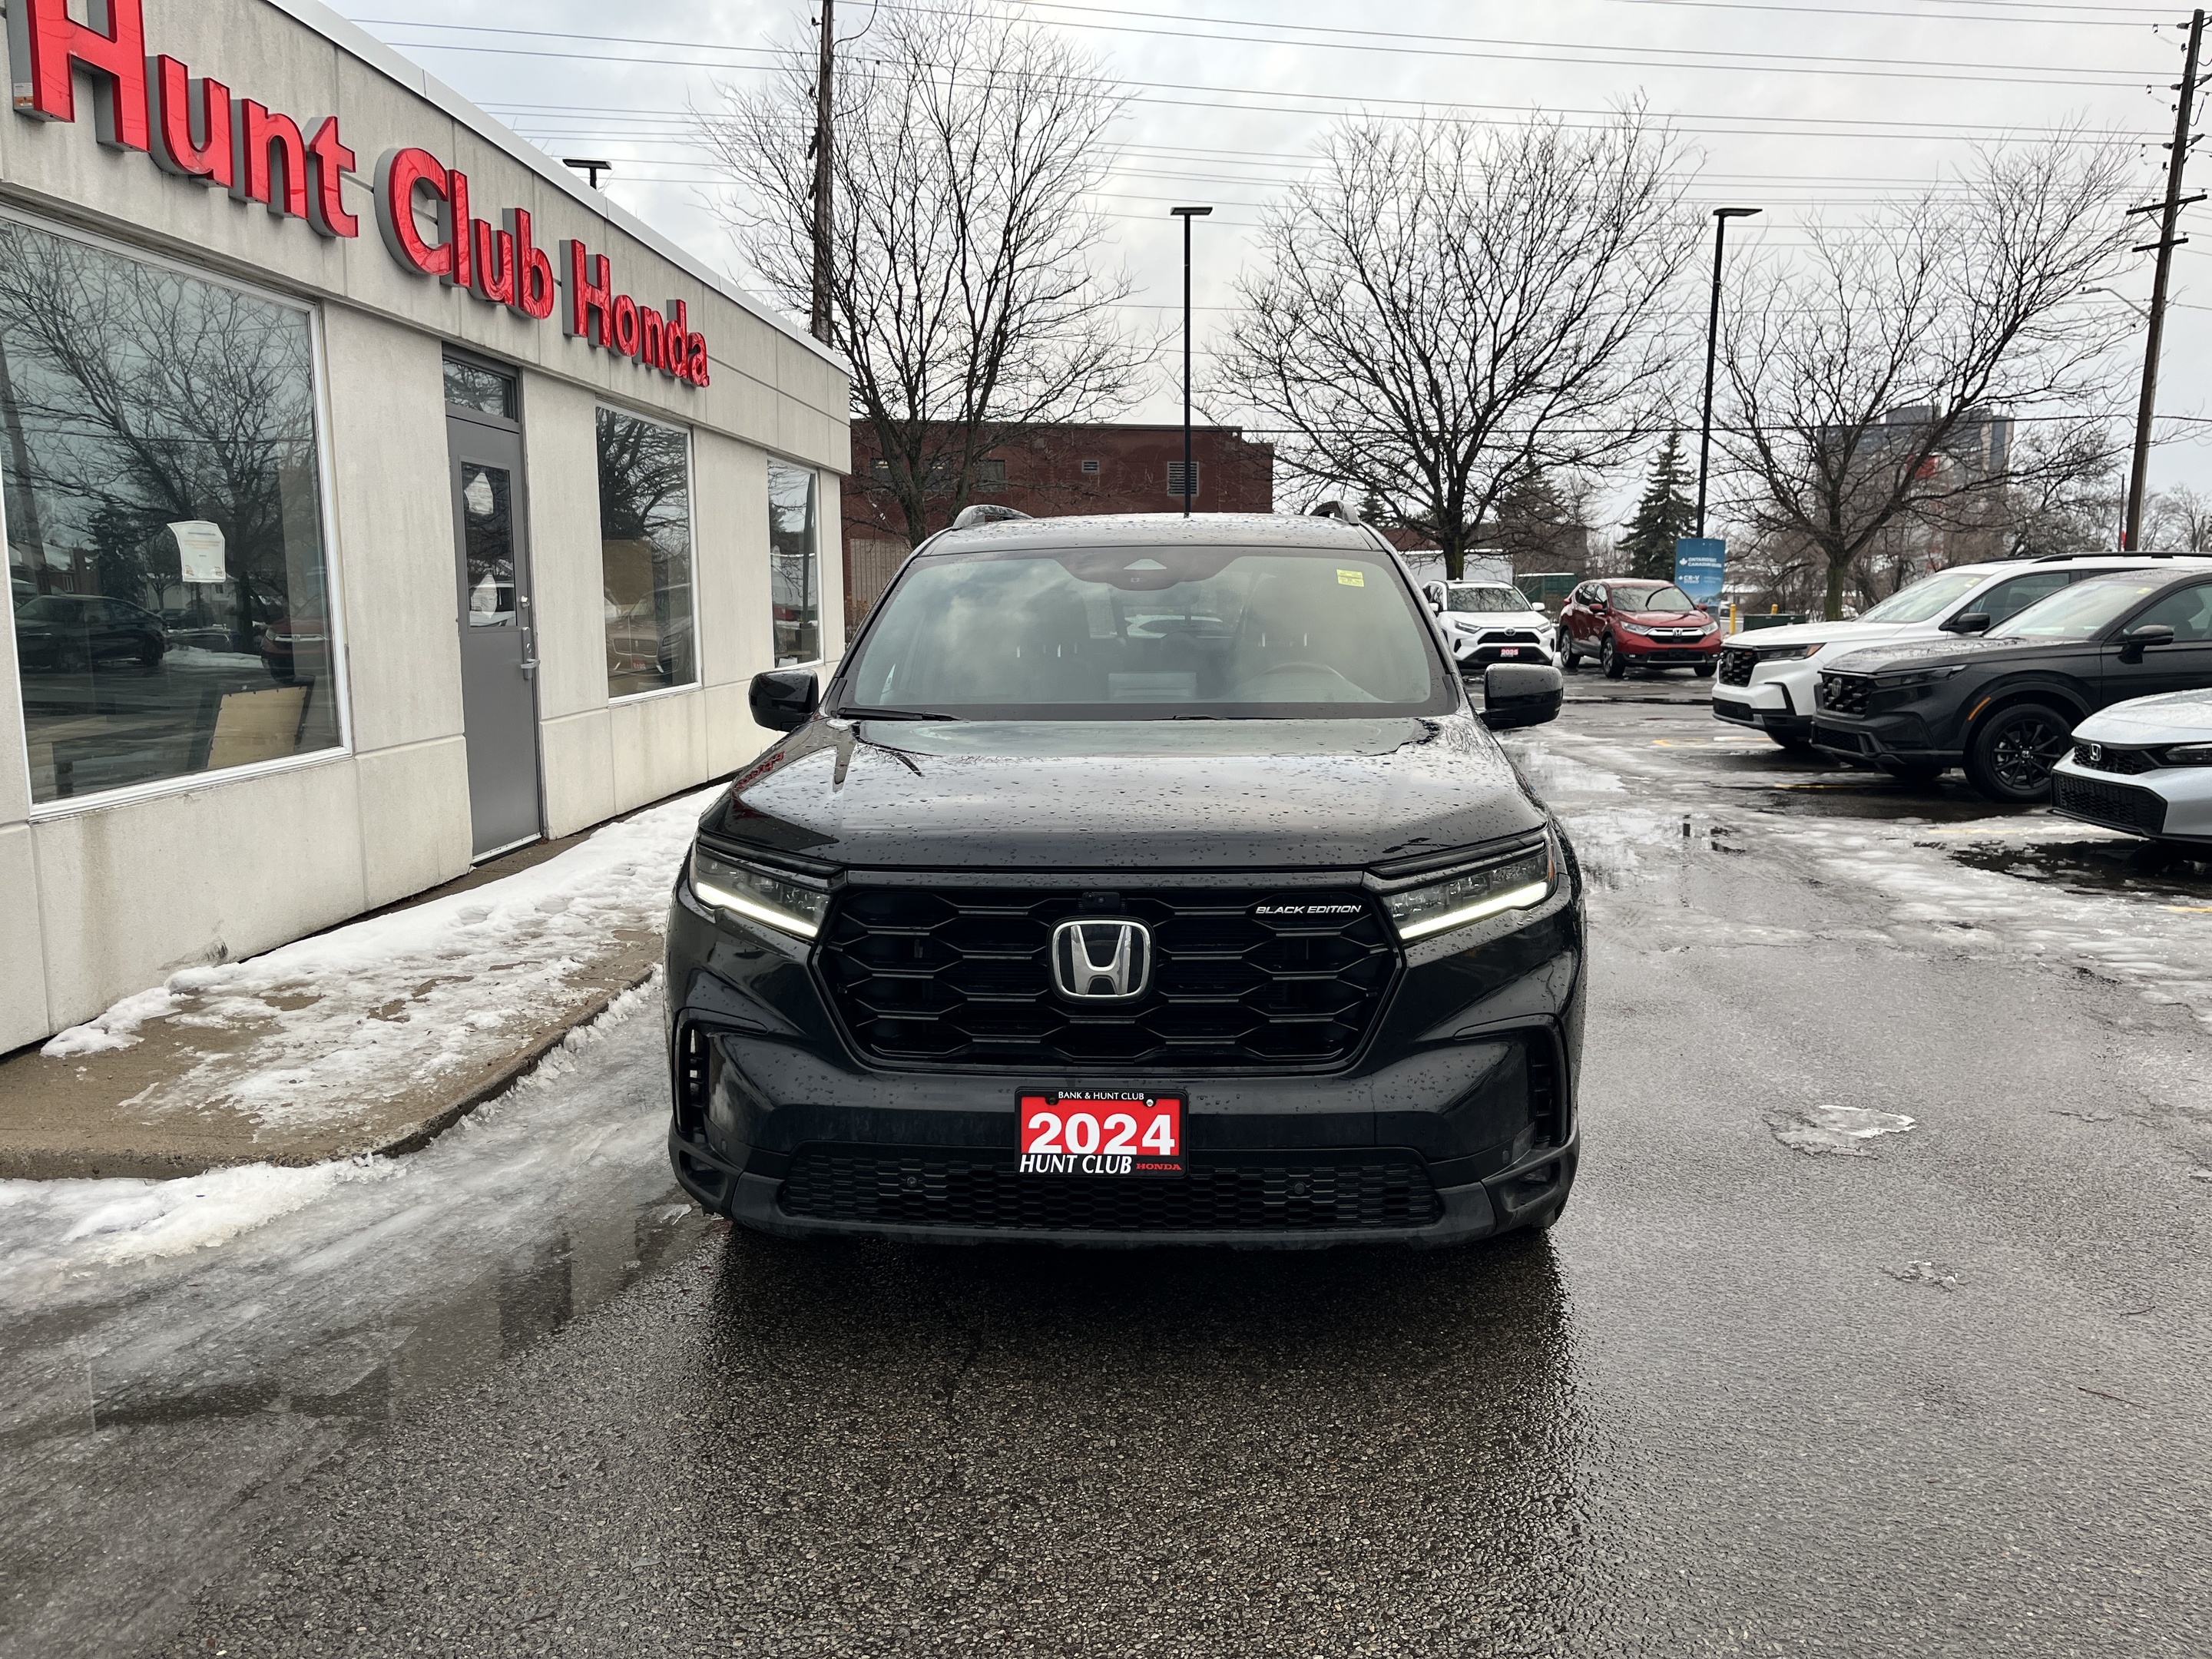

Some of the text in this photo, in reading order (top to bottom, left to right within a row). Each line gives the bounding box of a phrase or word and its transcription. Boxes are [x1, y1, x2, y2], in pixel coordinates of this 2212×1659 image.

[8, 0, 709, 388] Hunt Club Honda
[1255, 905, 1362, 914] BLACK EDITION
[1028, 1112, 1175, 1155] 2024
[1019, 1154, 1078, 1173] HUNT
[1082, 1155, 1133, 1174] CLUB
